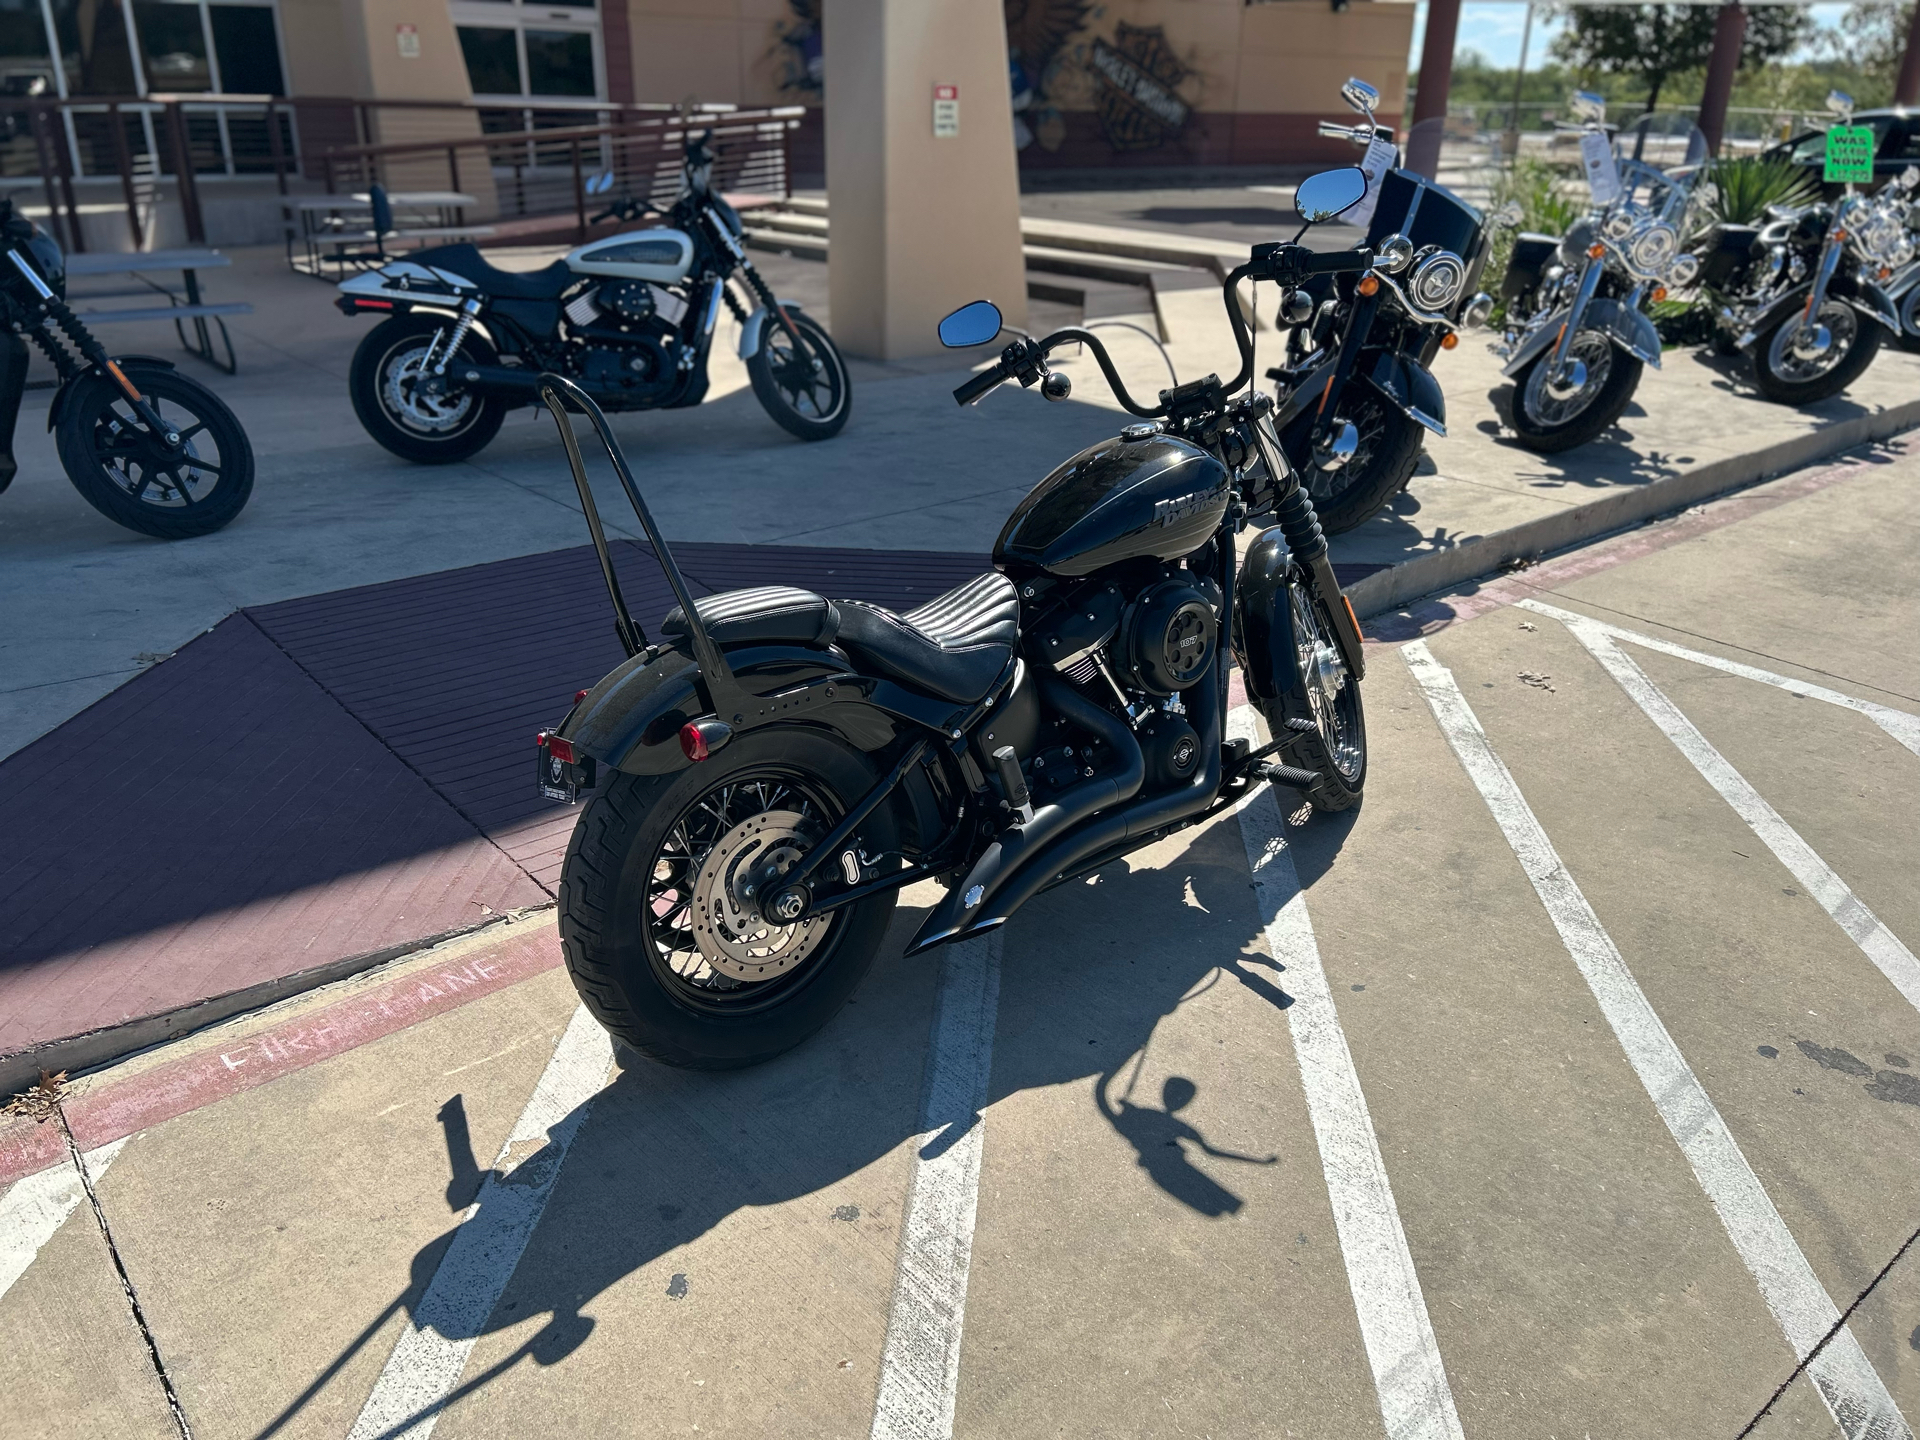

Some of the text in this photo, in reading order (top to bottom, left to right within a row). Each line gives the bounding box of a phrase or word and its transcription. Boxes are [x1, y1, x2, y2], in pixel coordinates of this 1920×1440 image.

[1834, 136, 1867, 145] WAS
[1832, 158, 1865, 166] NOW
[1180, 636, 1198, 648] 107
